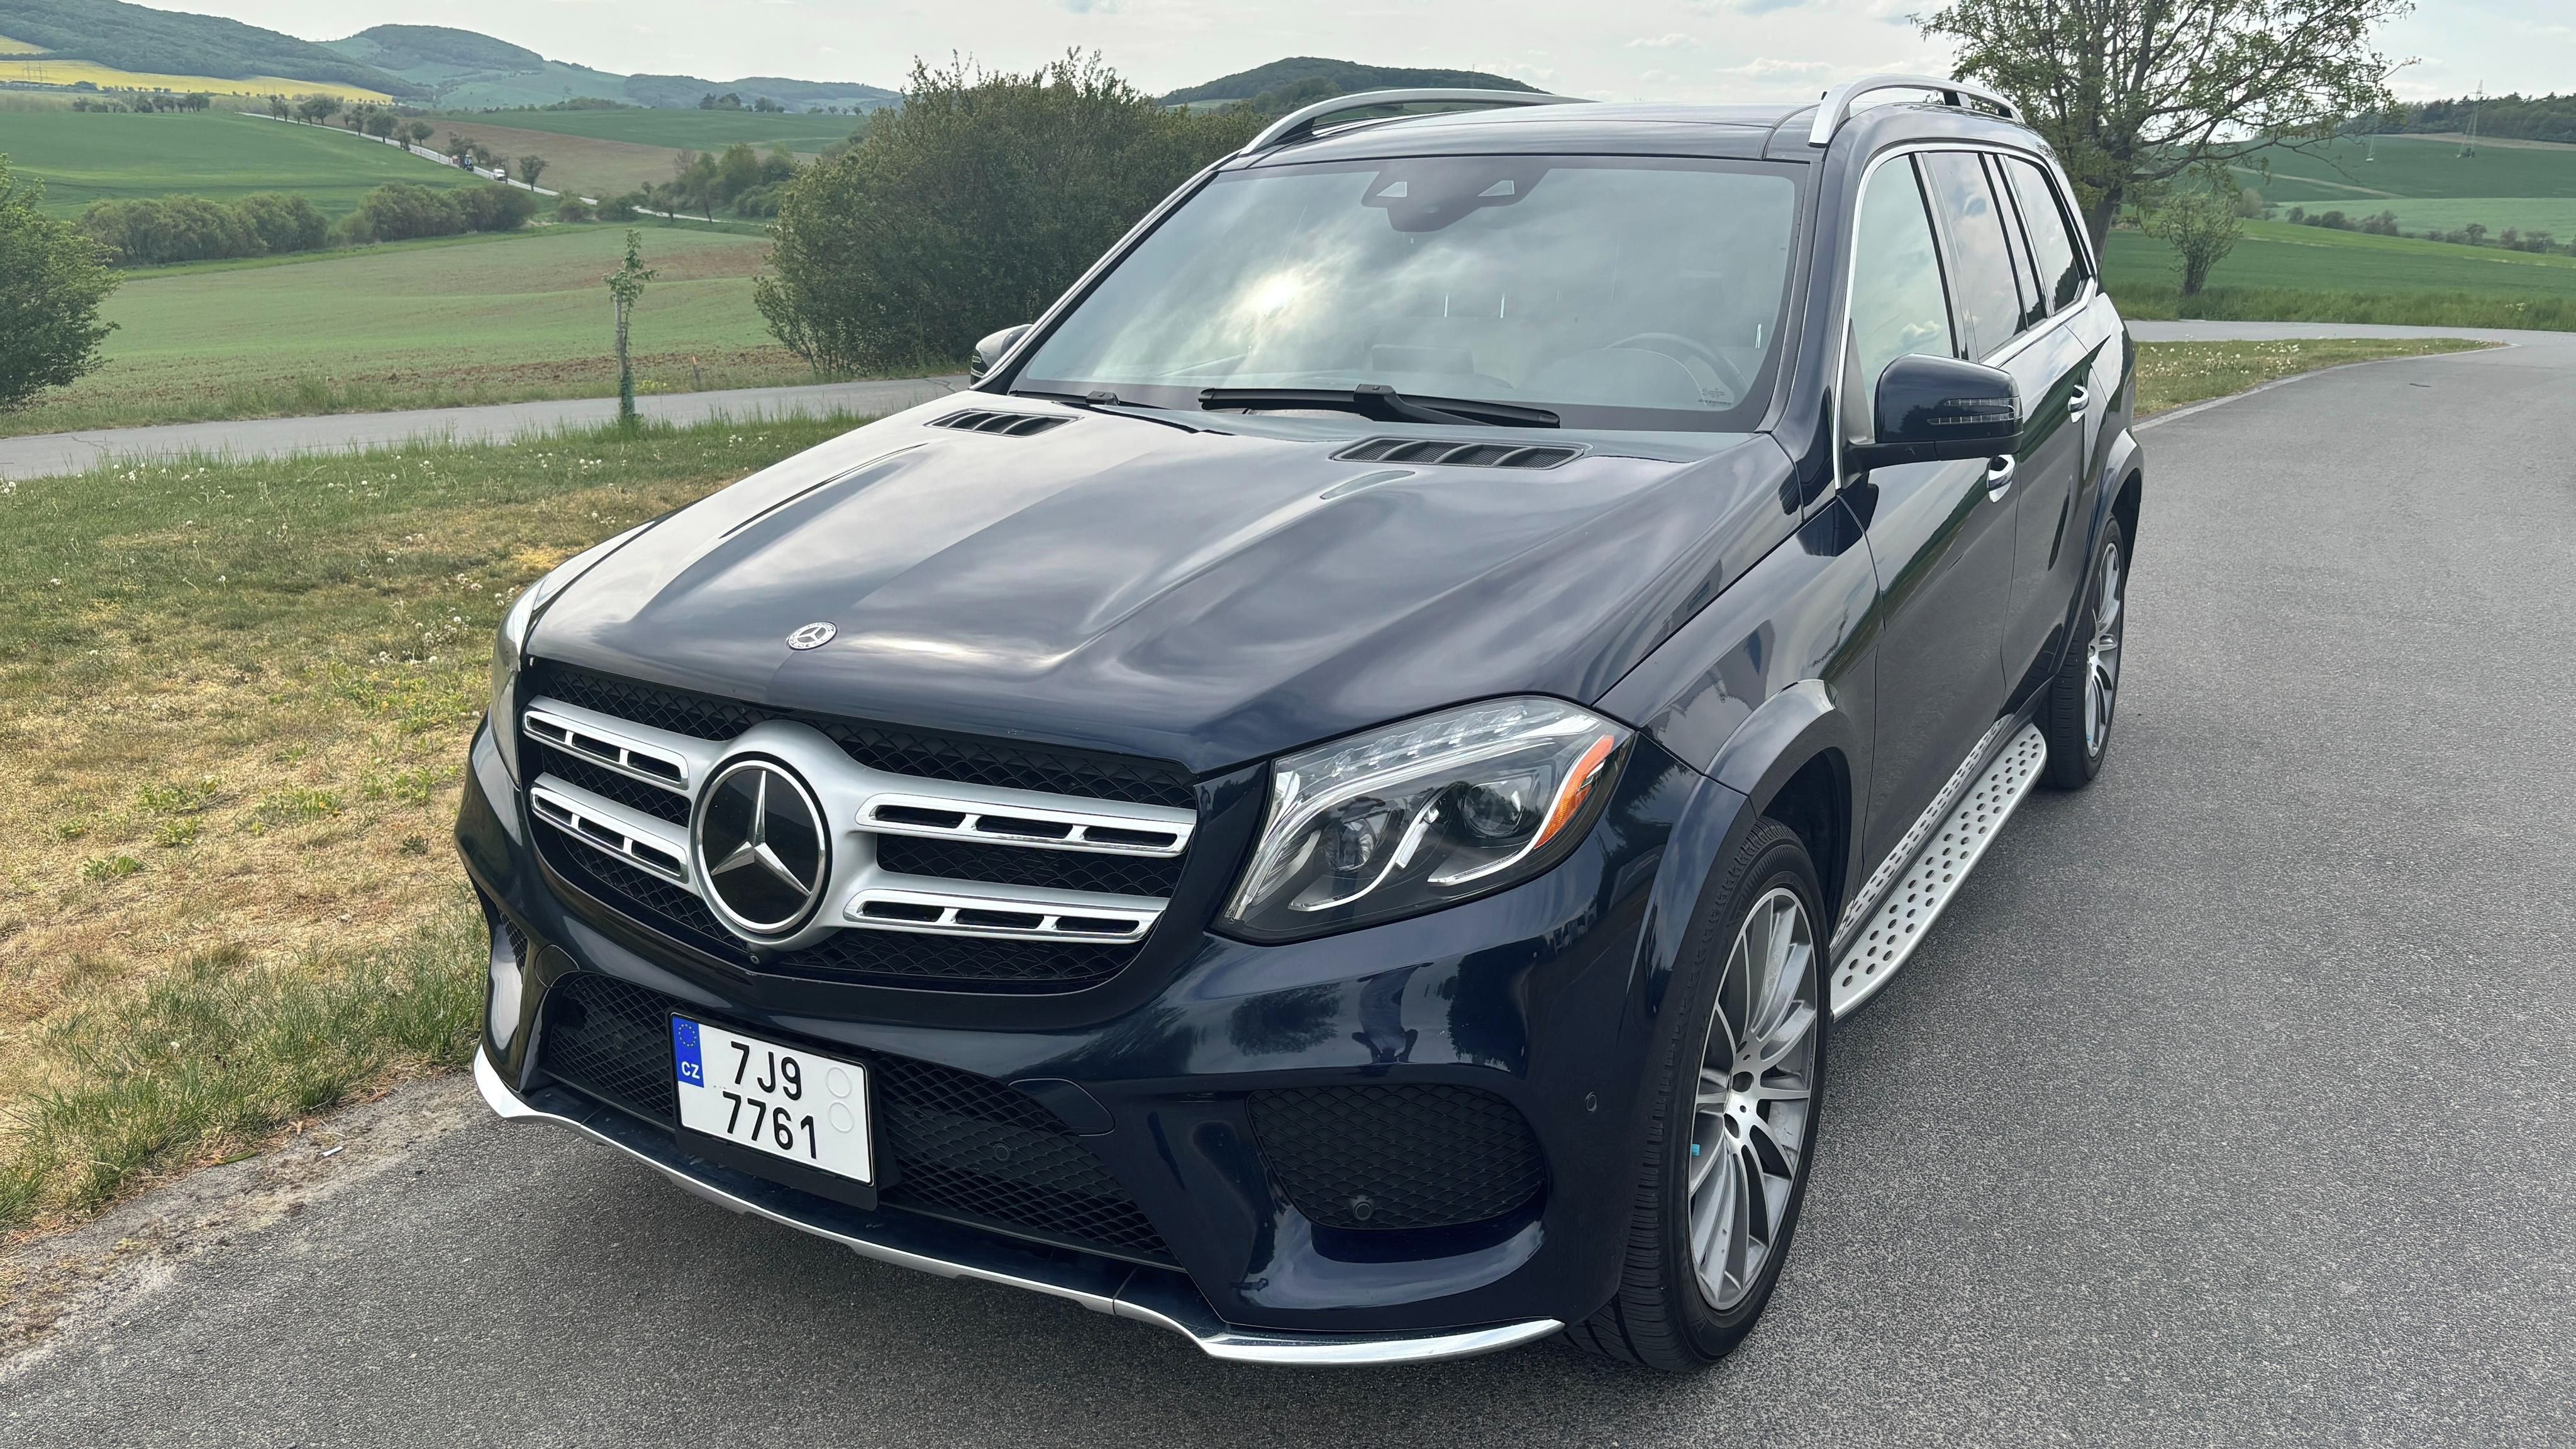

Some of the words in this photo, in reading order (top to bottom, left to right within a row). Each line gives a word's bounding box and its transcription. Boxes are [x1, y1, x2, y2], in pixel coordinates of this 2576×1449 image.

[681, 1062, 700, 1079] CZ
[731, 1041, 802, 1101] 7J9
[723, 1091, 816, 1159] 7761
